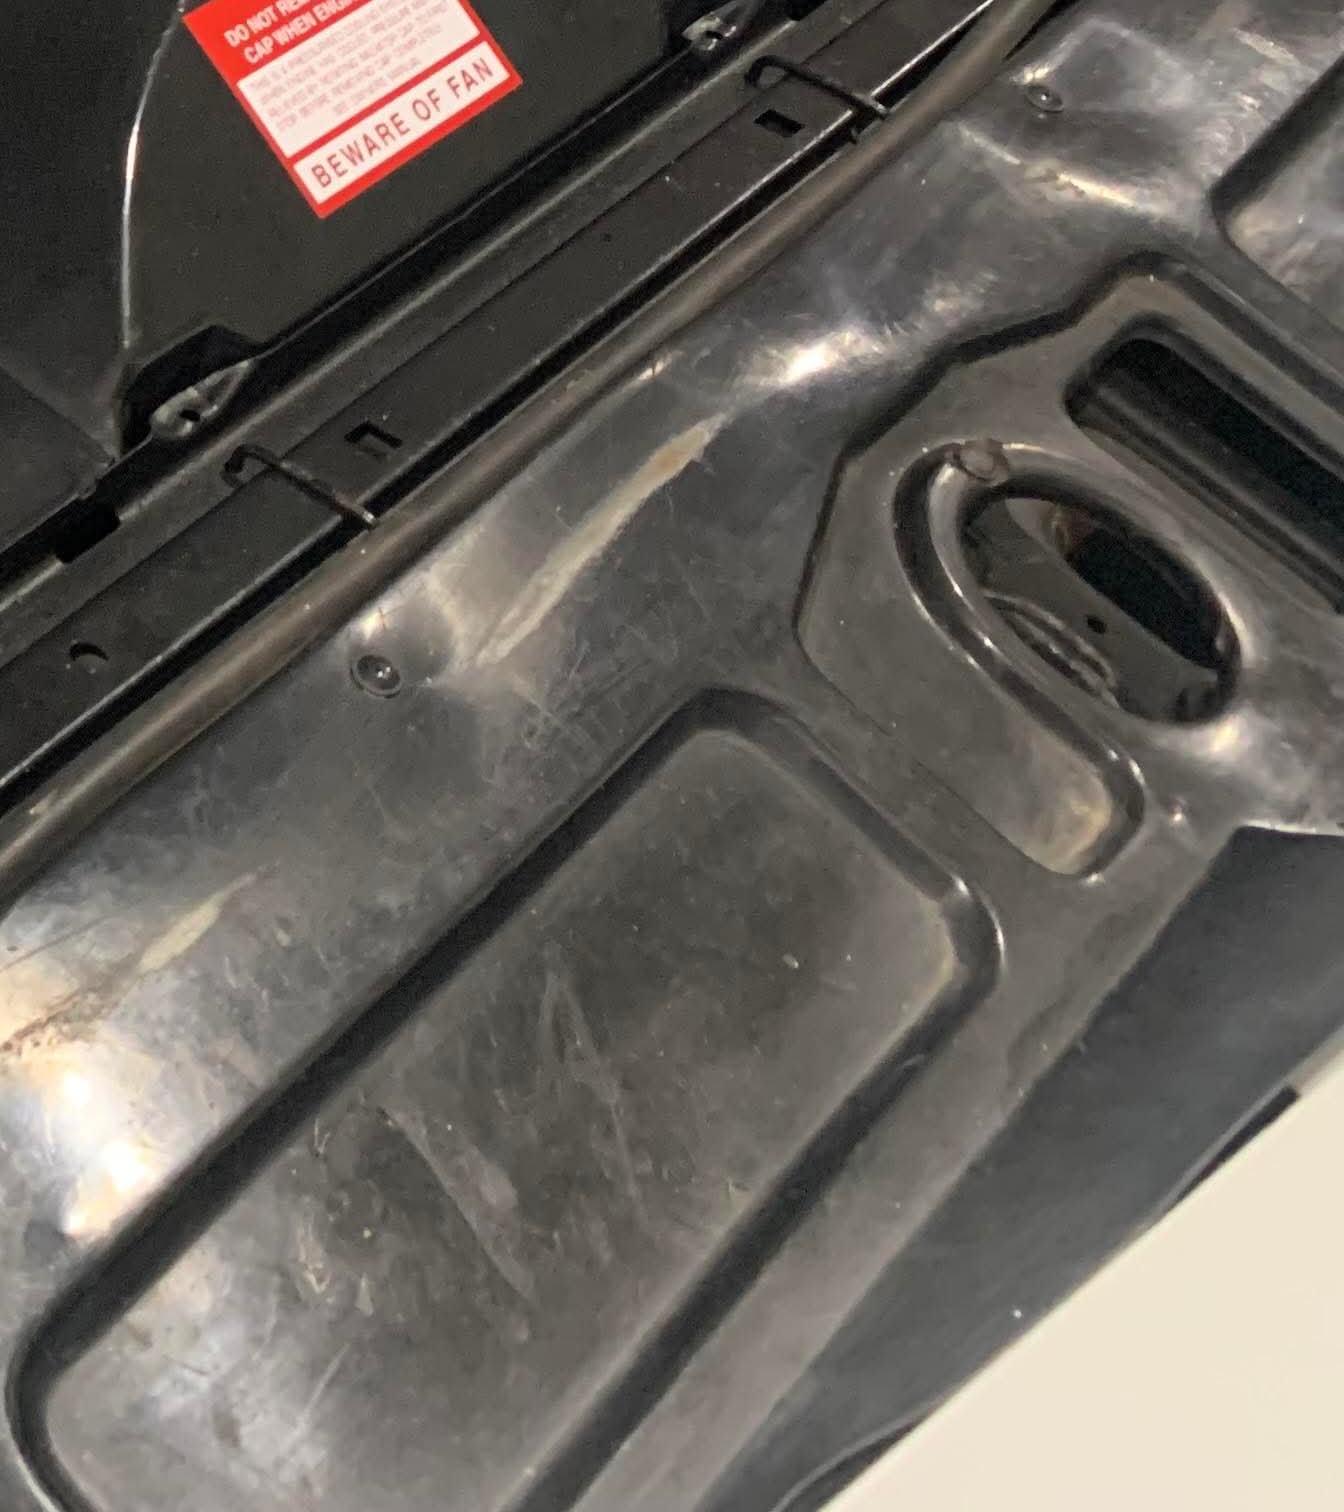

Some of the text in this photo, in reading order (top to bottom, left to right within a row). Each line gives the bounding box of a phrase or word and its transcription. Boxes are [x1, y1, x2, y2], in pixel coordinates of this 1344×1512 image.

[224, 24, 250, 46] DO
[247, 7, 278, 33] NOT
[242, 36, 276, 64] CAP
[273, 12, 316, 45] WHEN
[310, 57, 493, 187] BEWARE OF FAN
